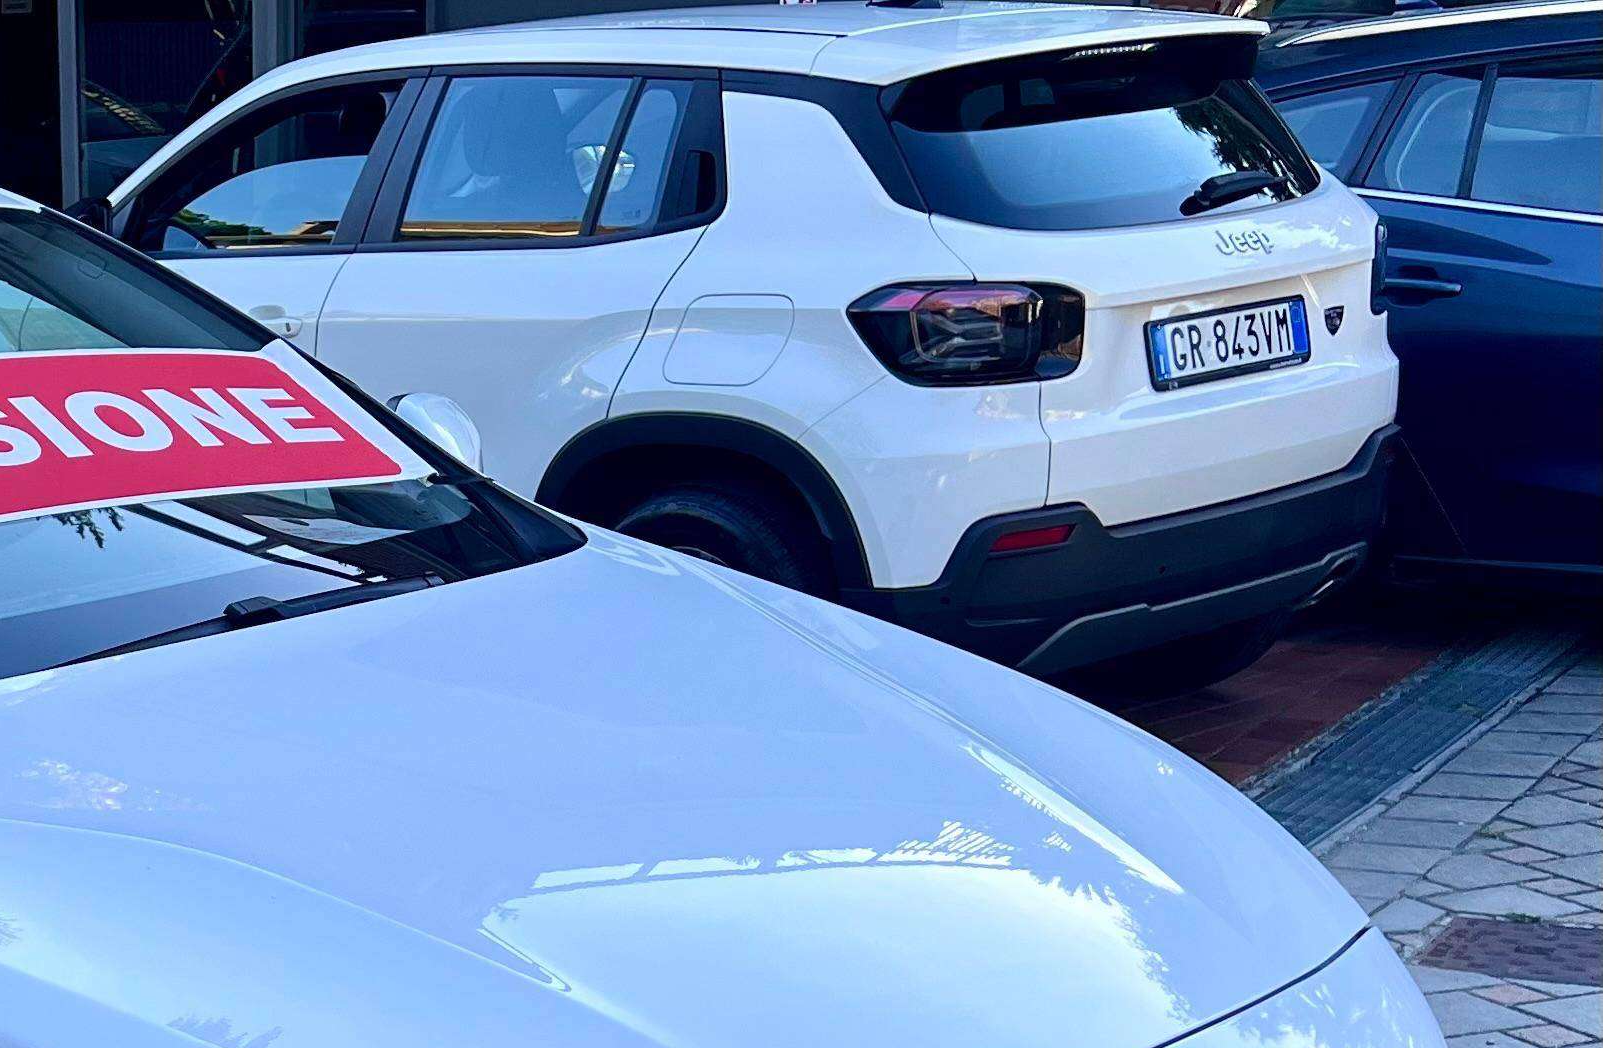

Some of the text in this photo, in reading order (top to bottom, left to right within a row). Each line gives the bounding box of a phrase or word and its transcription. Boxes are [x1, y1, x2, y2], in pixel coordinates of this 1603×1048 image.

[1214, 229, 1275, 256] Jeep
[1170, 324, 1206, 371] GR
[1212, 307, 1293, 363] 843VM
